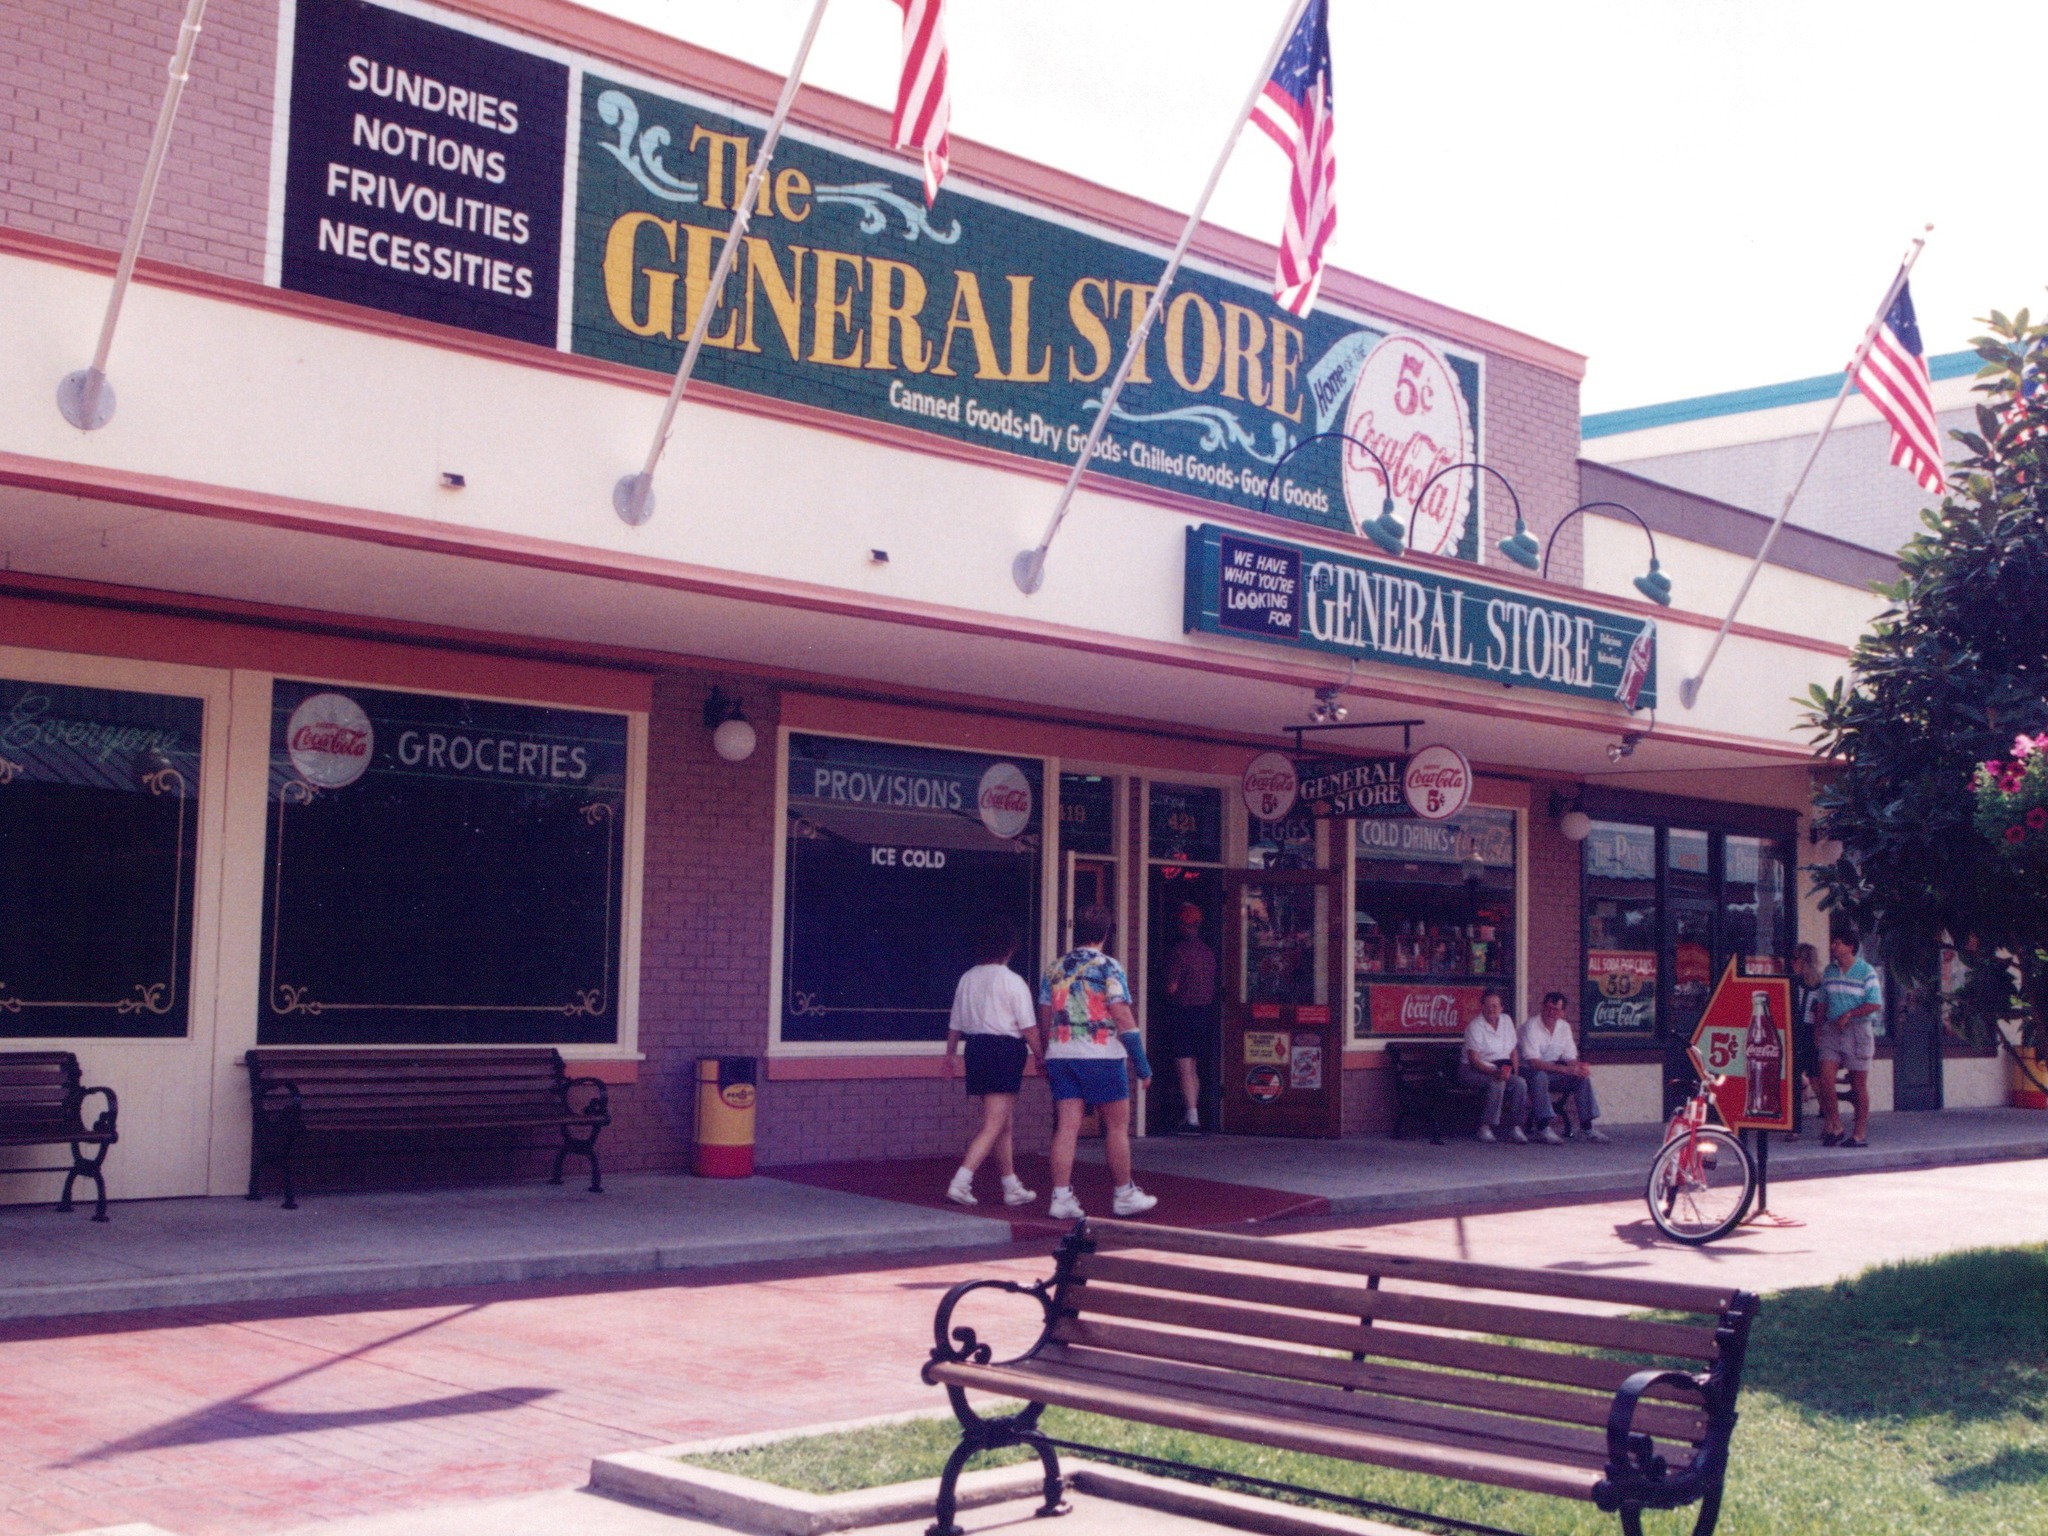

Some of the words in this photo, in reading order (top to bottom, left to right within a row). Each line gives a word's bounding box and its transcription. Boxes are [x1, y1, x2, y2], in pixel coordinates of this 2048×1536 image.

[348, 55, 519, 134] SUNDRIES
[353, 113, 506, 184] NOTIONS
[690, 124, 812, 222] The
[327, 163, 530, 245] FRIVOLITIES
[318, 218, 533, 299] NECESSITIES
[602, 210, 1052, 384] GENERAL
[1068, 276, 1304, 423] STORE
[1313, 365, 1347, 418] Home
[889, 379, 960, 423] Canned
[966, 398, 1022, 439] Goods
[1029, 413, 1062, 453] Dry
[1130, 440, 1184, 477] Chilled
[1186, 454, 1234, 490] Goods
[1241, 467, 1279, 501] Good
[1283, 478, 1329, 513] Goods
[1224, 566, 1257, 587] WHAT
[1258, 573, 1295, 594] YOU'RE
[1234, 550, 1254, 568] WE
[1256, 555, 1289, 575] HAVE
[1227, 586, 1288, 610] LOOKING
[1268, 610, 1292, 628] FOR
[1307, 560, 1473, 667] GENERAL
[1487, 598, 1594, 687] STORE
[0, 689, 178, 764] Everyone
[398, 730, 587, 780] GROCERIES
[814, 768, 962, 810] PROVISIONS
[1300, 761, 1400, 801] GENERAL
[1334, 782, 1401, 815] STORE
[1362, 820, 1399, 848] COLD
[1402, 823, 1449, 853] DRINKS
[870, 847, 897, 866] ICE
[901, 849, 945, 869] COLD
[1588, 957, 1601, 971] ALL
[1401, 993, 1459, 1028] Coca-Cola
[1709, 1032, 1739, 1068] 5¢
[1746, 1044, 1780, 1058] Coca-Cola
